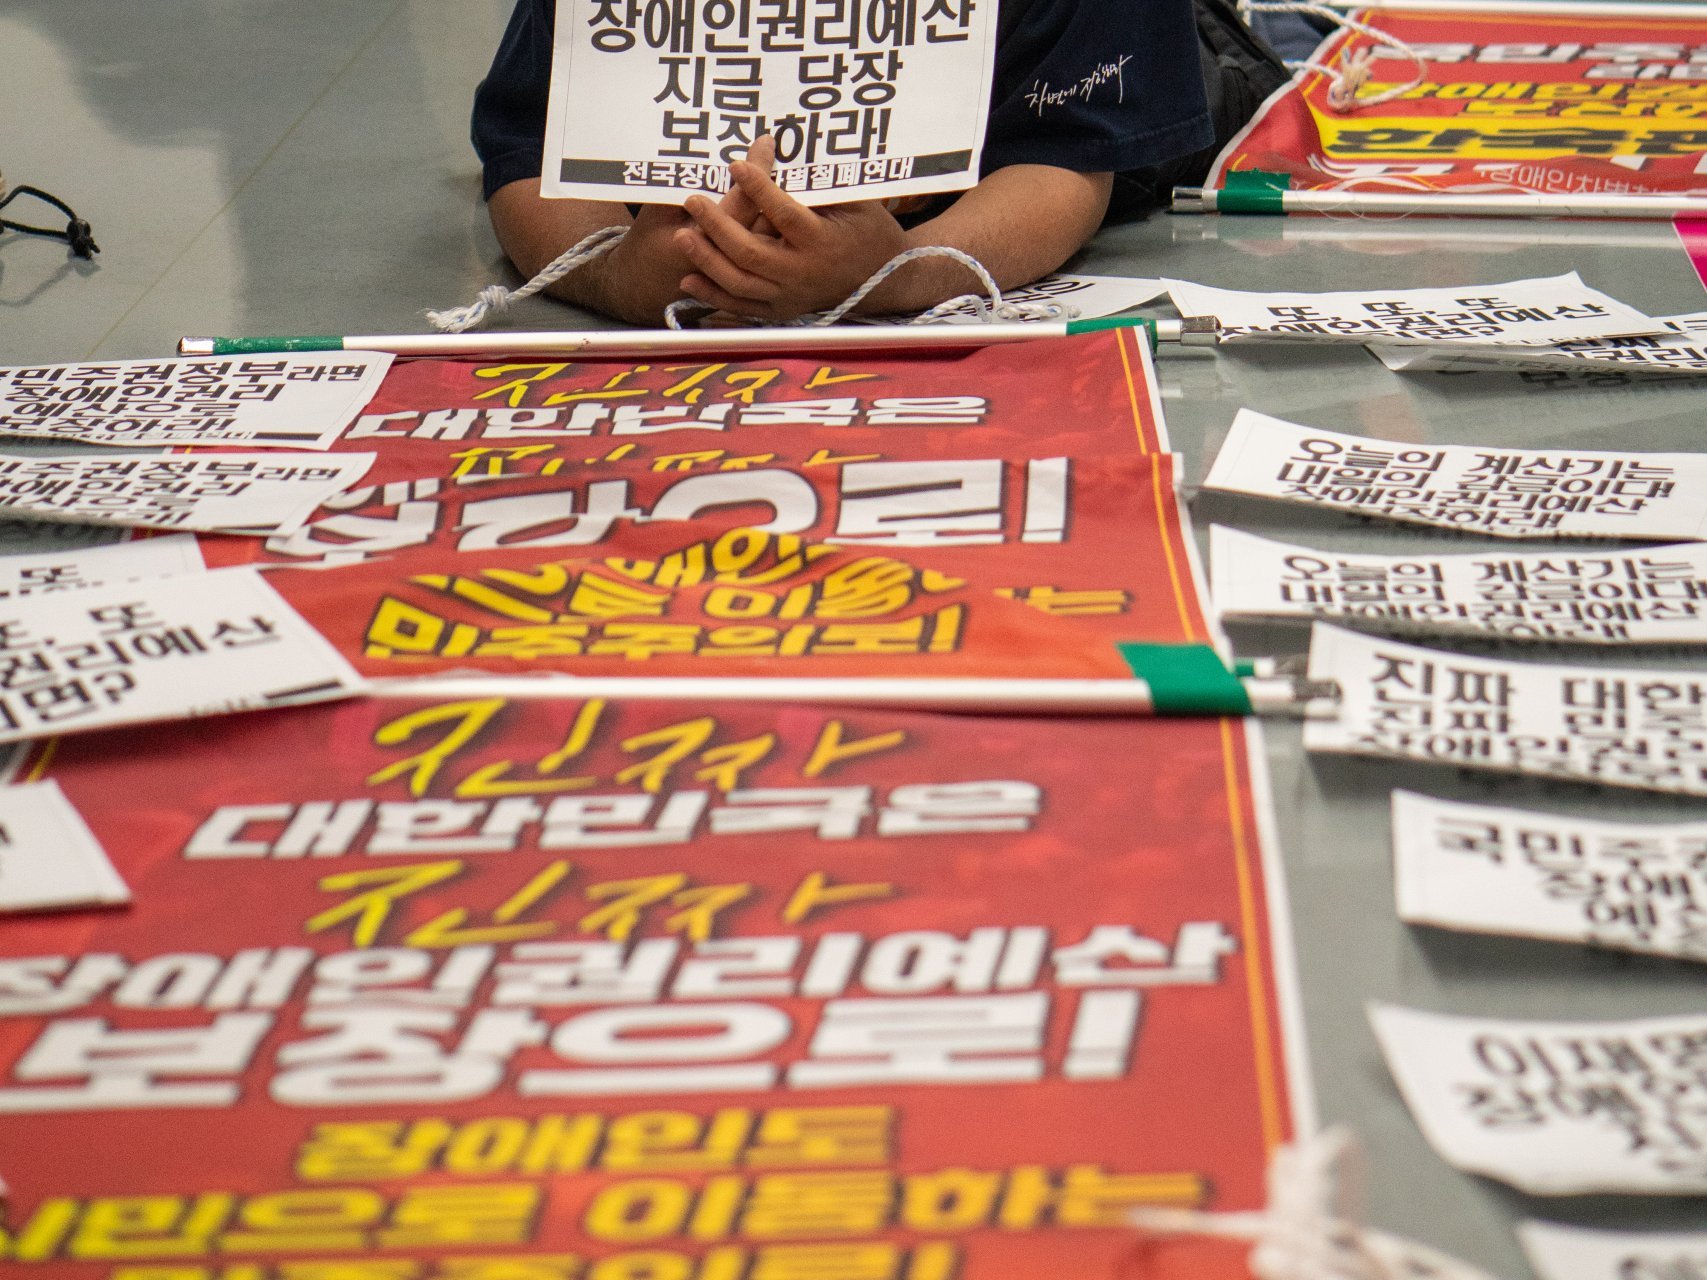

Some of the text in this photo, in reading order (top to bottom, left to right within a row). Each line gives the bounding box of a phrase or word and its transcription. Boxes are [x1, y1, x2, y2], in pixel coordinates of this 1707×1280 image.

[653, 49, 904, 111] 지금 당장
[657, 107, 892, 164] 보장하라!
[622, 157, 914, 195] 전국장애별철폐연대
[0, 361, 367, 387] 민주권정부라면
[5, 384, 285, 403] 장애인권리
[0, 461, 342, 481] 주권정부라면
[1277, 462, 1431, 489] 내일의
[1290, 438, 1675, 480] 오늘의 계산기는
[0, 480, 251, 497] 애인권리
[1282, 554, 1697, 583] 오늘의 계산기는
[367, 698, 905, 797] 진짜
[184, 780, 1042, 859] 대한민국은
[304, 859, 895, 948] 진짜
[0, 921, 1238, 1016] 장애인권리예산
[0, 988, 1143, 1111] 보장으로!
